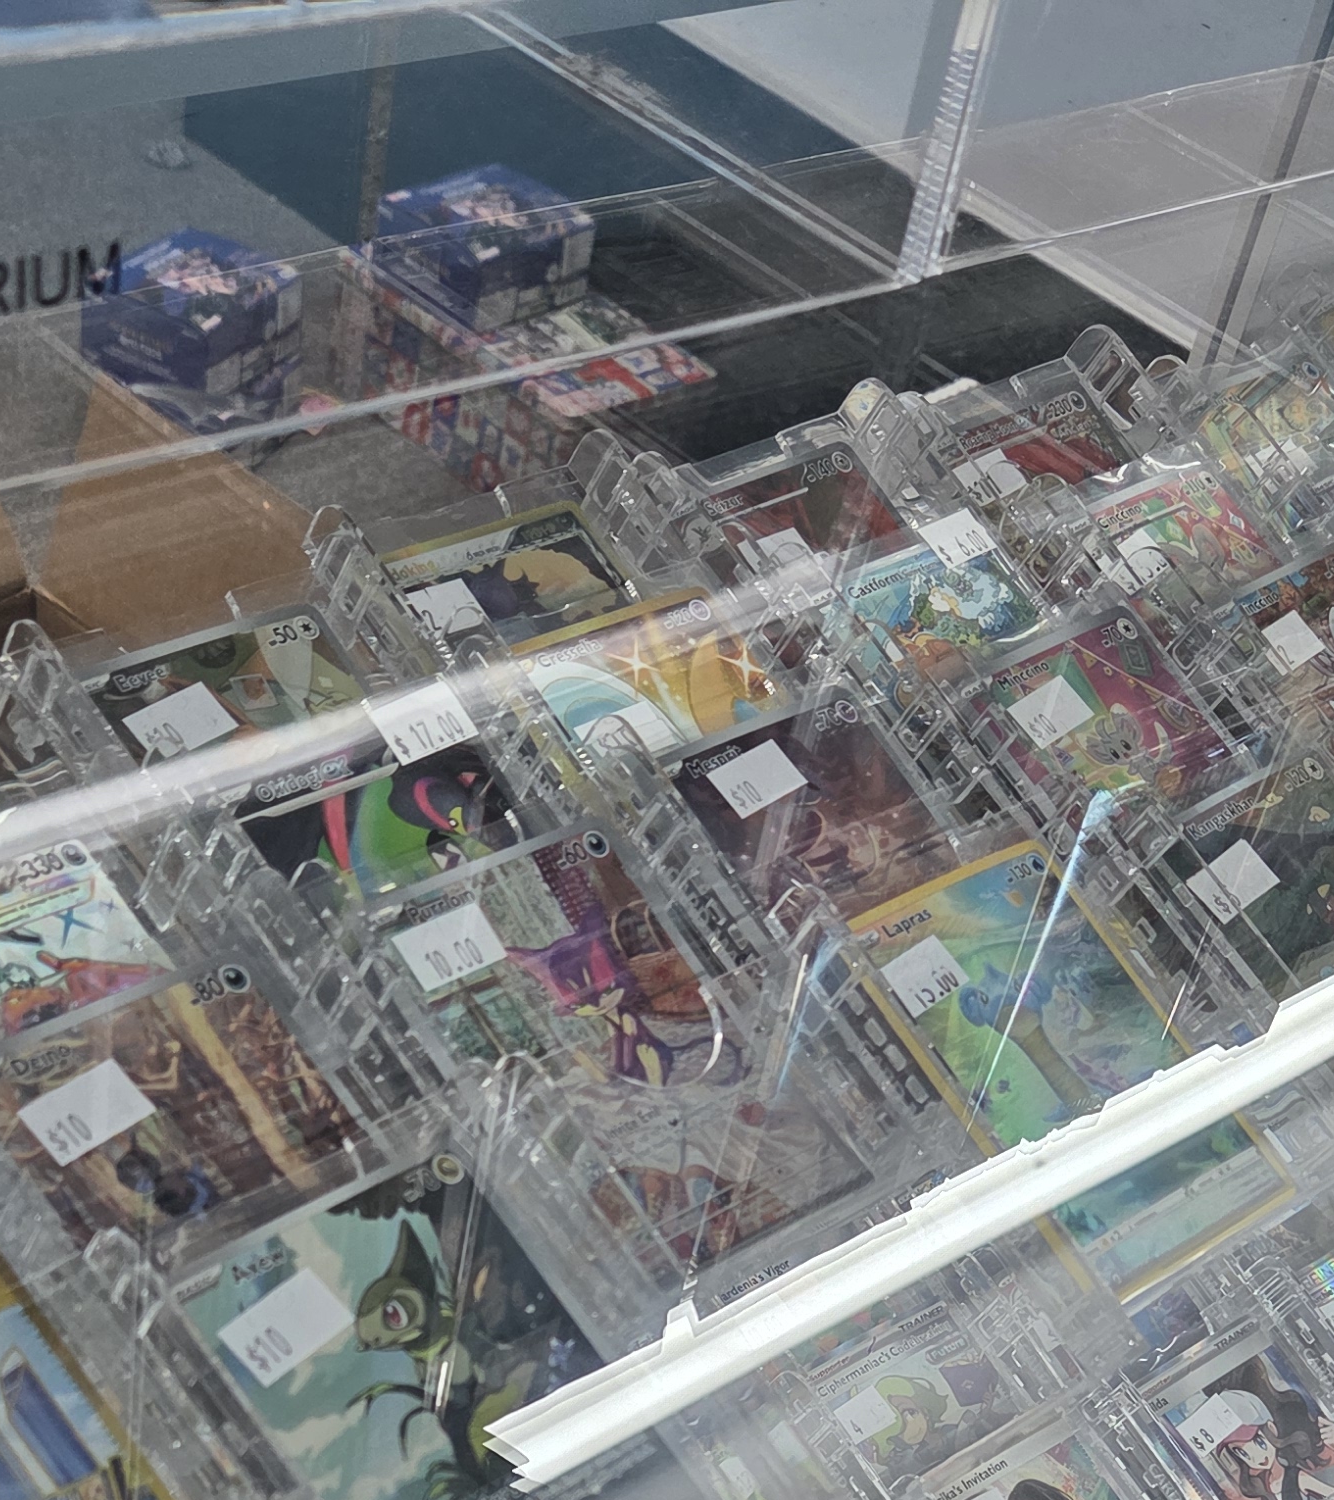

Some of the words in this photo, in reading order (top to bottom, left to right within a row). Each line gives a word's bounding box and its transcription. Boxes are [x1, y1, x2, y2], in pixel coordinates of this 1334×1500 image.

[706, 494, 744, 520] Scizor
[1098, 503, 1144, 530] Cinccino
[957, 528, 990, 558] 6.00
[112, 663, 168, 694] Eevee
[996, 659, 1051, 692] Minccino
[410, 708, 466, 751] 17.00
[1029, 710, 1060, 741] $10
[729, 778, 763, 810] $10
[1186, 795, 1256, 842] Kangaskhan
[880, 907, 933, 940] Lapras
[10, 1041, 72, 1081] Deino
[46, 1113, 94, 1155] $10
[230, 1246, 289, 1288] Axew
[898, 1304, 946, 1334] TRAINER
[245, 1327, 295, 1374] $10
[1212, 1321, 1259, 1351] TRAINER
[963, 1457, 1010, 1491] Invitation
